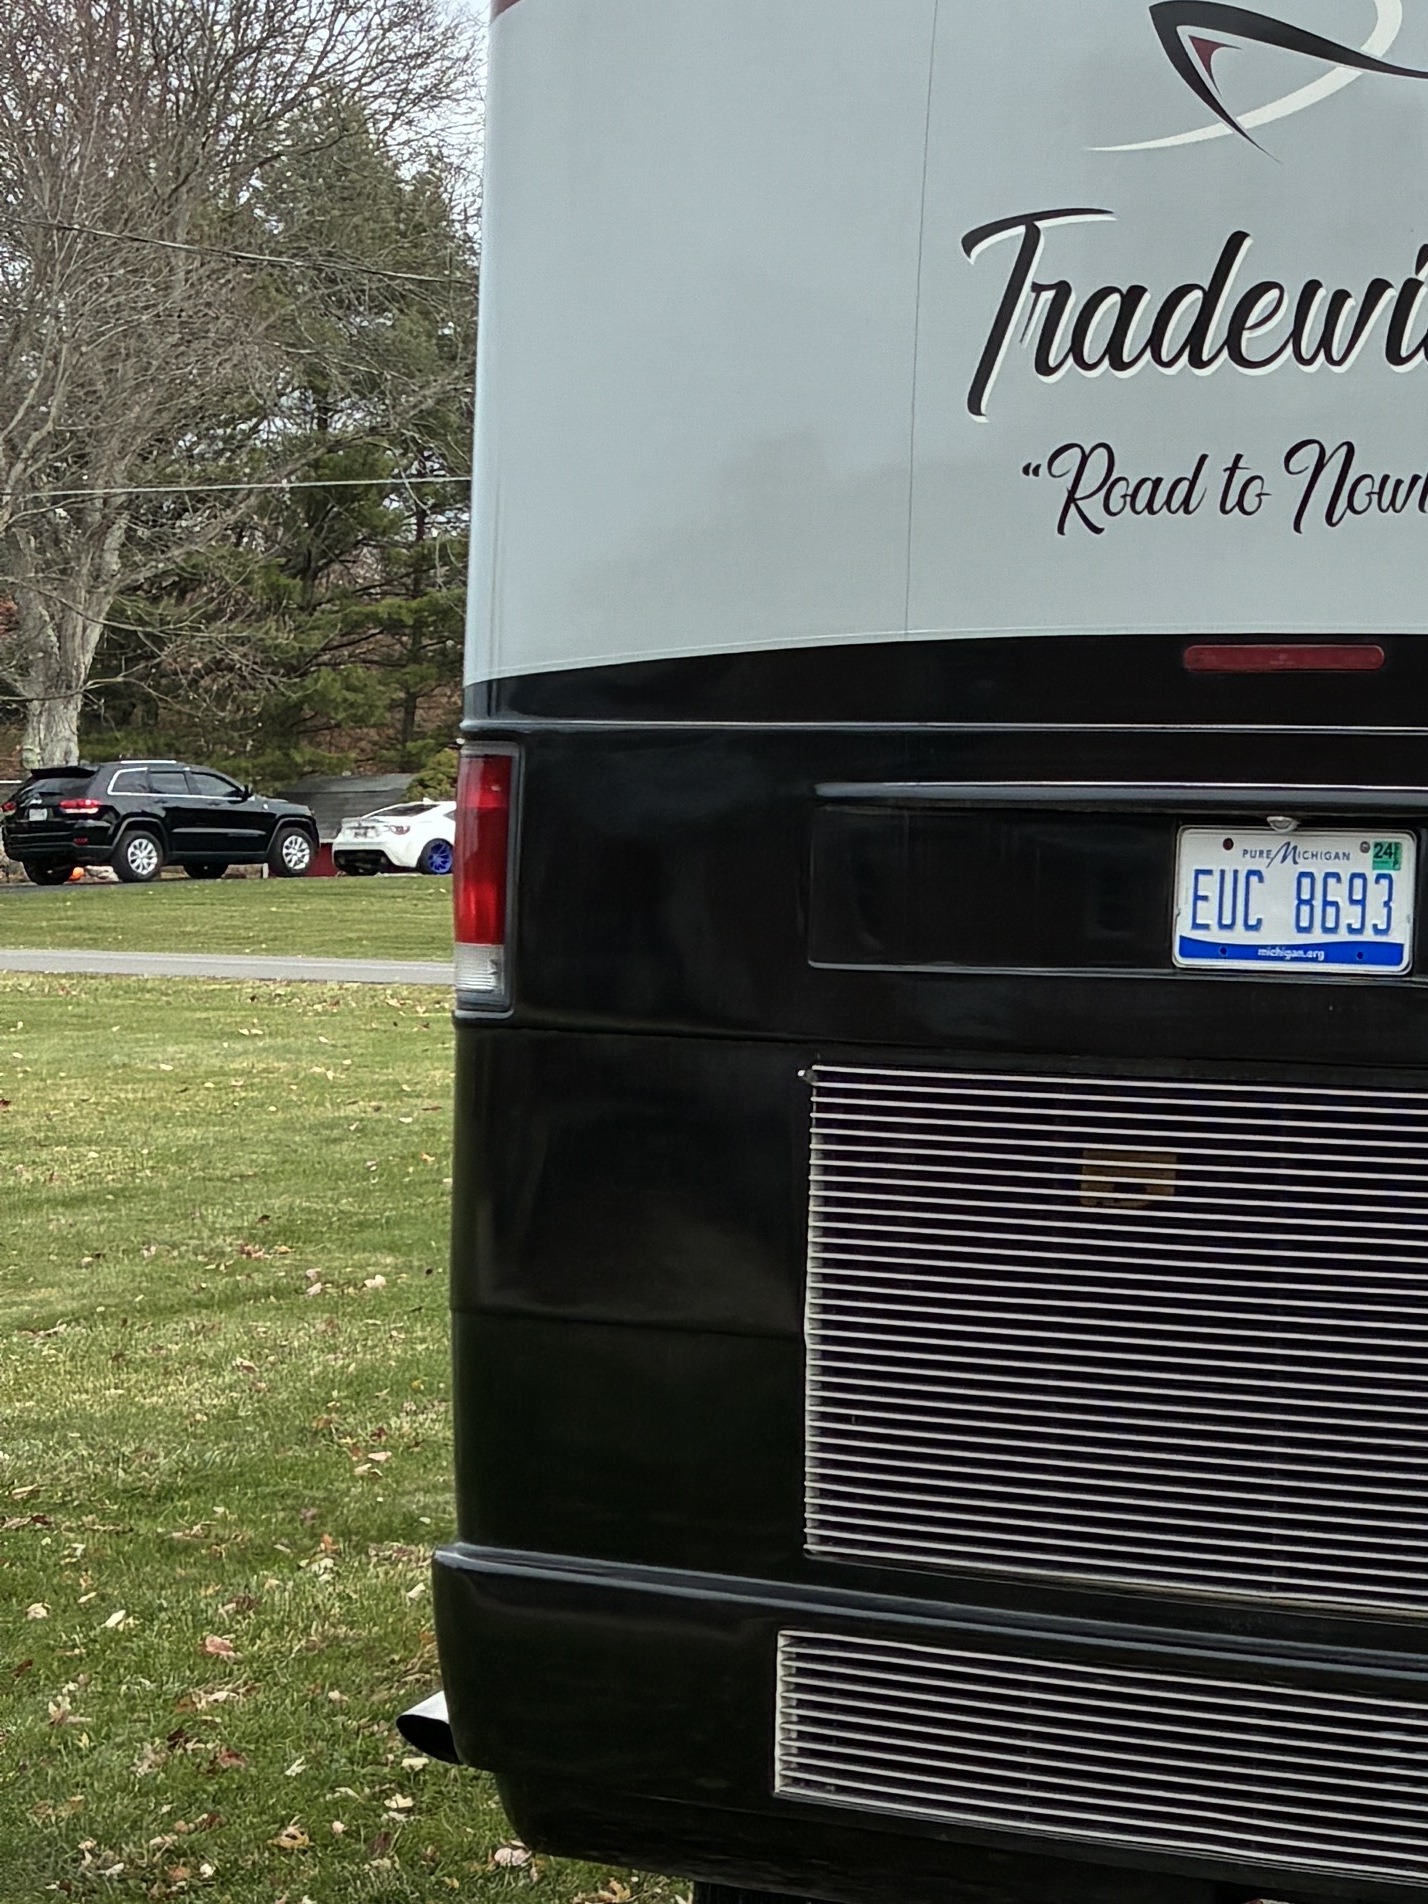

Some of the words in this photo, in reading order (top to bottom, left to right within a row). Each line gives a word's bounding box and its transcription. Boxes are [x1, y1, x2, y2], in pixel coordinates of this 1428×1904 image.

[1219, 454, 1270, 518] to
[1242, 848, 1273, 860] PURE
[1373, 842, 1393, 859] 24
[1190, 868, 1265, 932] EUC
[1294, 871, 1394, 936] 8693
[1257, 946, 1325, 962] michigan.org
